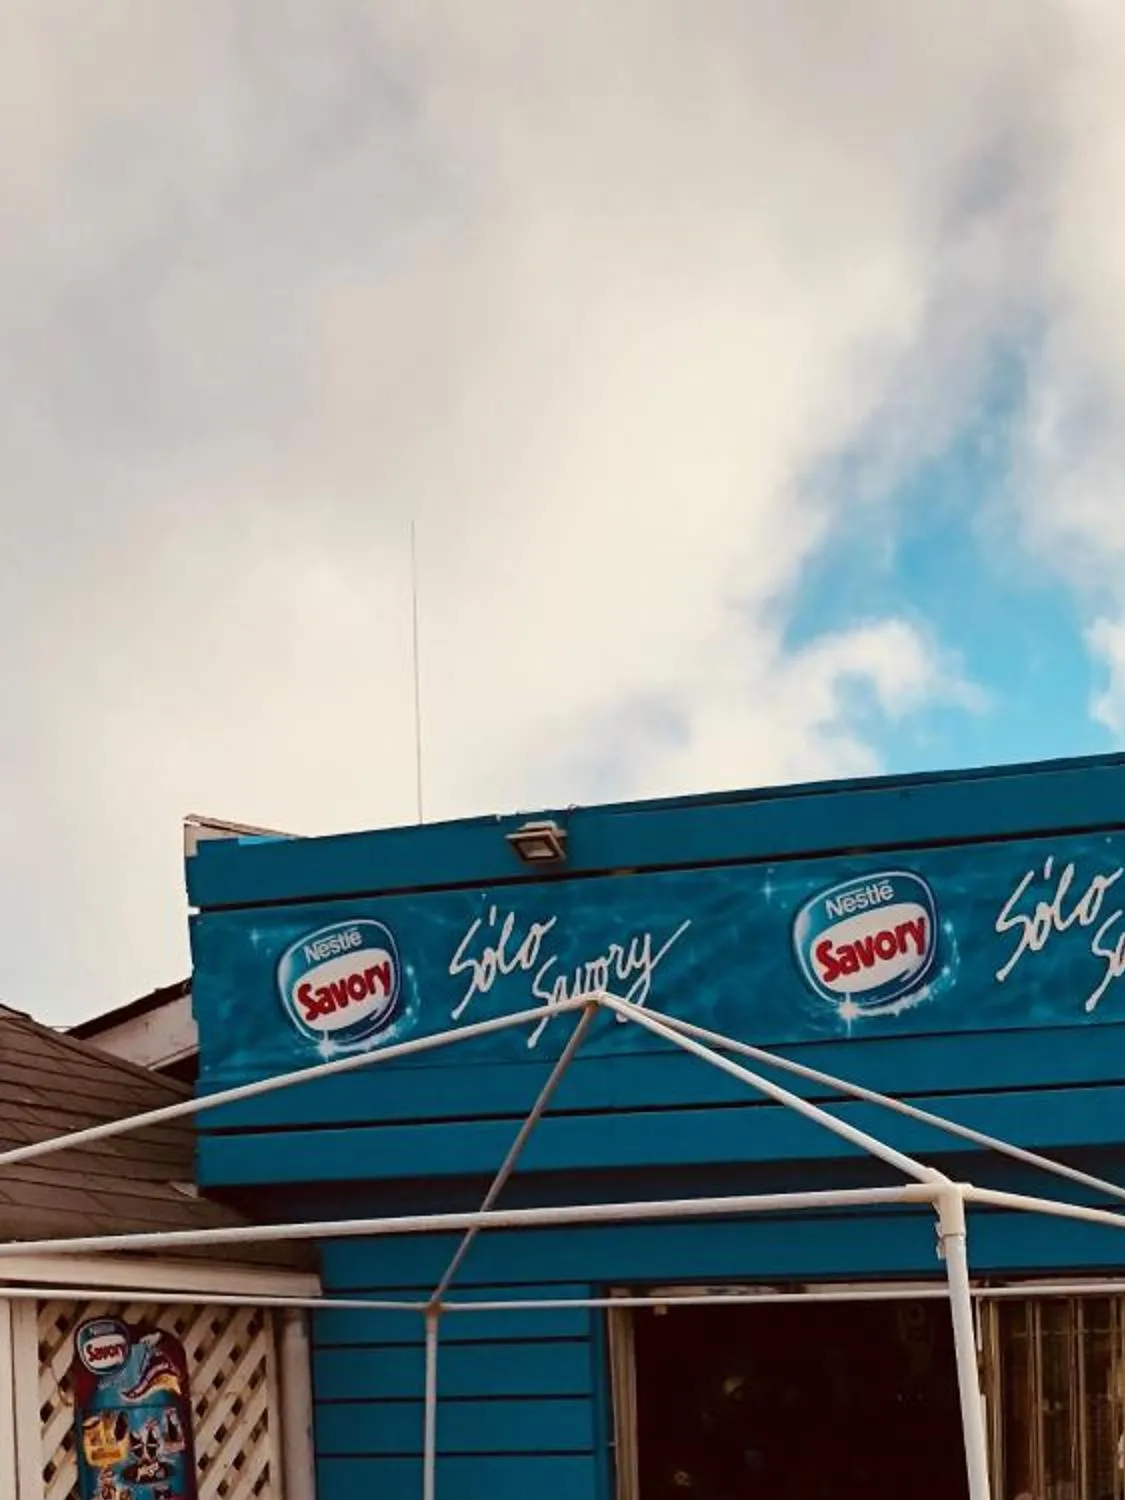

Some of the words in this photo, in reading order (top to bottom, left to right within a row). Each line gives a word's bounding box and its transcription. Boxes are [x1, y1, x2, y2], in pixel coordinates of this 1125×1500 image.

[816, 916, 926, 983] Savory
[297, 960, 391, 1021] Savory
[526, 918, 693, 1049] Savory
